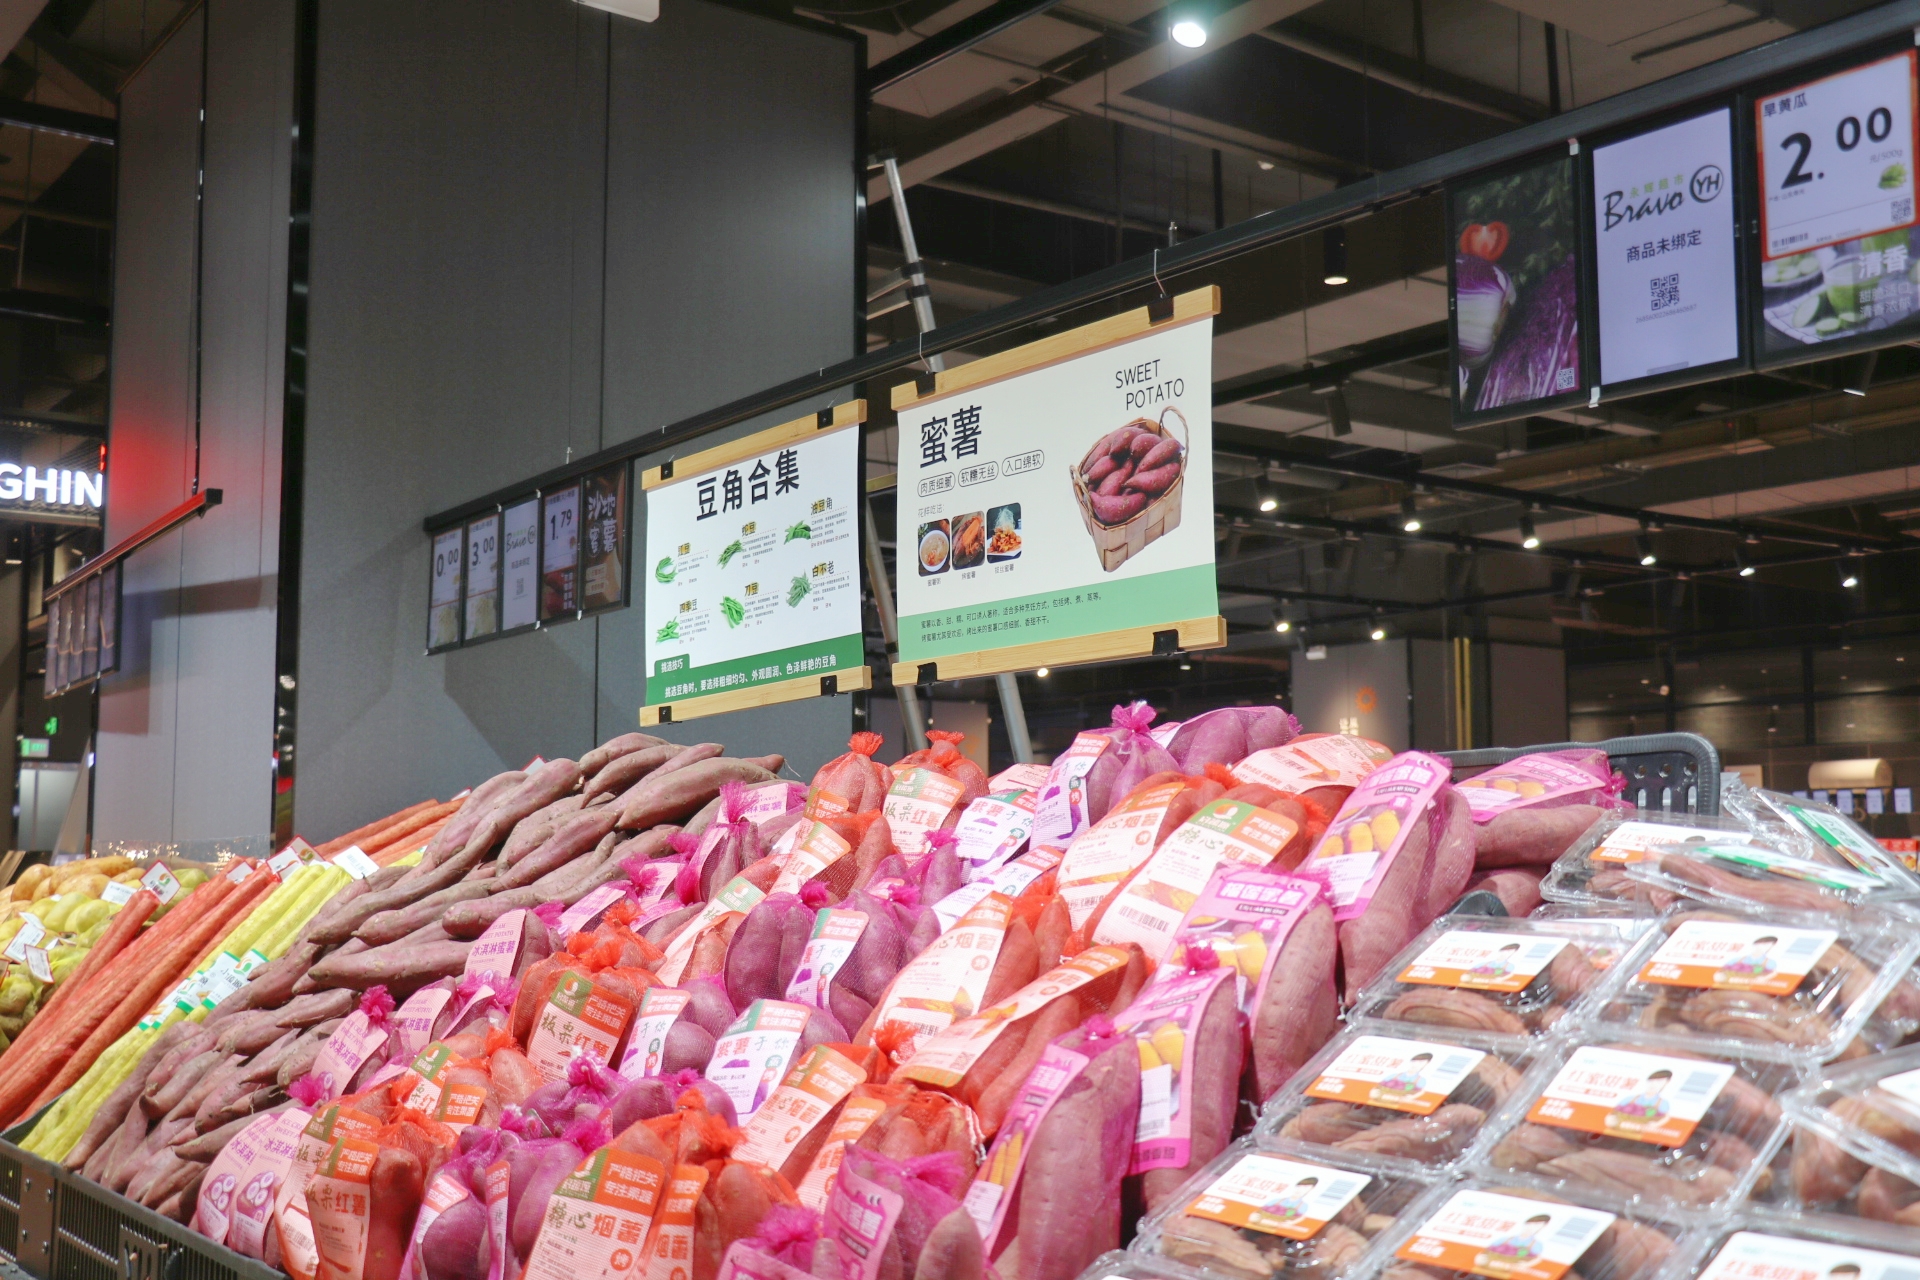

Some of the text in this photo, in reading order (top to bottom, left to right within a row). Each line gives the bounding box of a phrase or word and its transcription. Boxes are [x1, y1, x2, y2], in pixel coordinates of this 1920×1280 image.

[1780, 107, 1892, 190] 2.00
[1603, 190, 1685, 232] Bravo
[1626, 229, 1703, 263] 商品未绑定
[1859, 244, 1909, 279] 清香
[1115, 359, 1161, 389] SWEET
[1126, 378, 1184, 411] POTATO
[920, 405, 982, 468] 蜜薯
[1005, 453, 1041, 473] 入口绵软
[696, 448, 800, 521] 豆角合集
[920, 475, 953, 494] 肉质细腻
[551, 509, 573, 541] 1.79
[436, 548, 458, 577] 0.00
[472, 536, 495, 567] 3.00
[661, 658, 684, 673] 挑选技巧
[471, 940, 516, 957] 冰淇淋蜜薯
[329, 1036, 362, 1071] 冰淇淋蜜薯
[608, 1162, 659, 1188] 严格把关
[548, 1200, 644, 1245] 糖心烟薯
